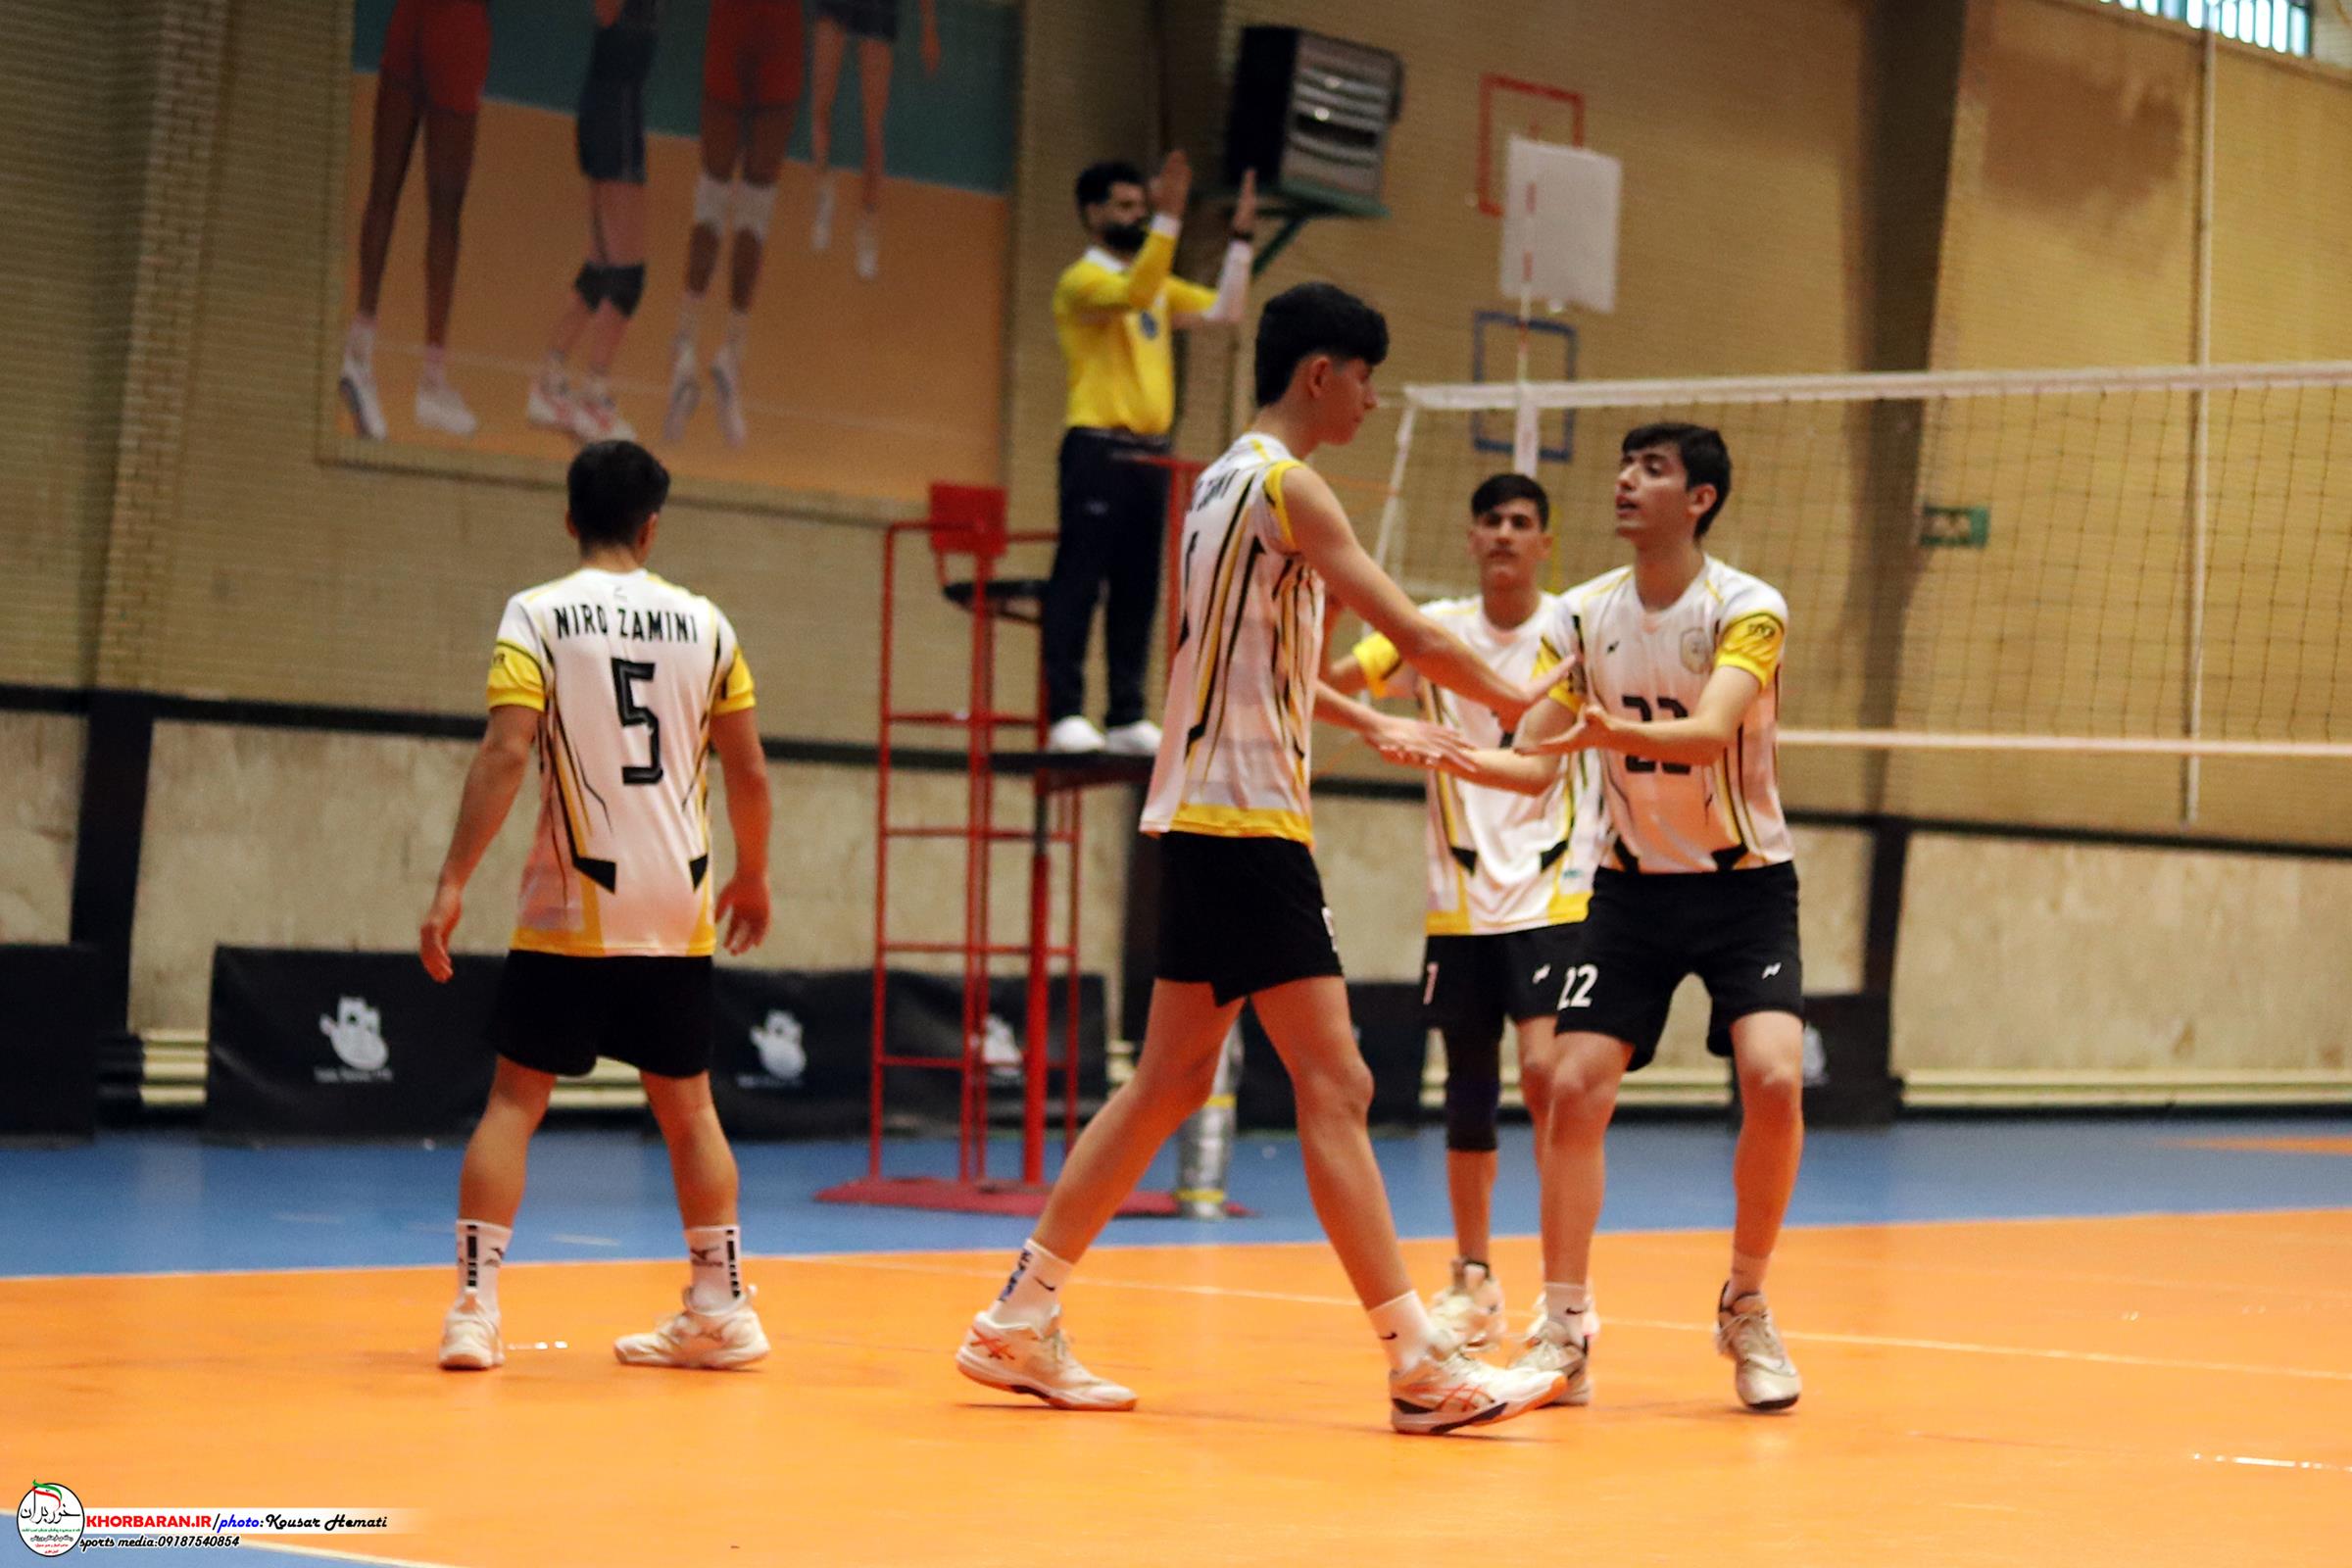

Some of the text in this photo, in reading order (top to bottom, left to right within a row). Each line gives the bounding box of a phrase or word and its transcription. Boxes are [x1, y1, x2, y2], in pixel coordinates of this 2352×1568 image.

[554, 604, 699, 643] NIRO ZAMINI
[610, 657, 664, 786] 5
